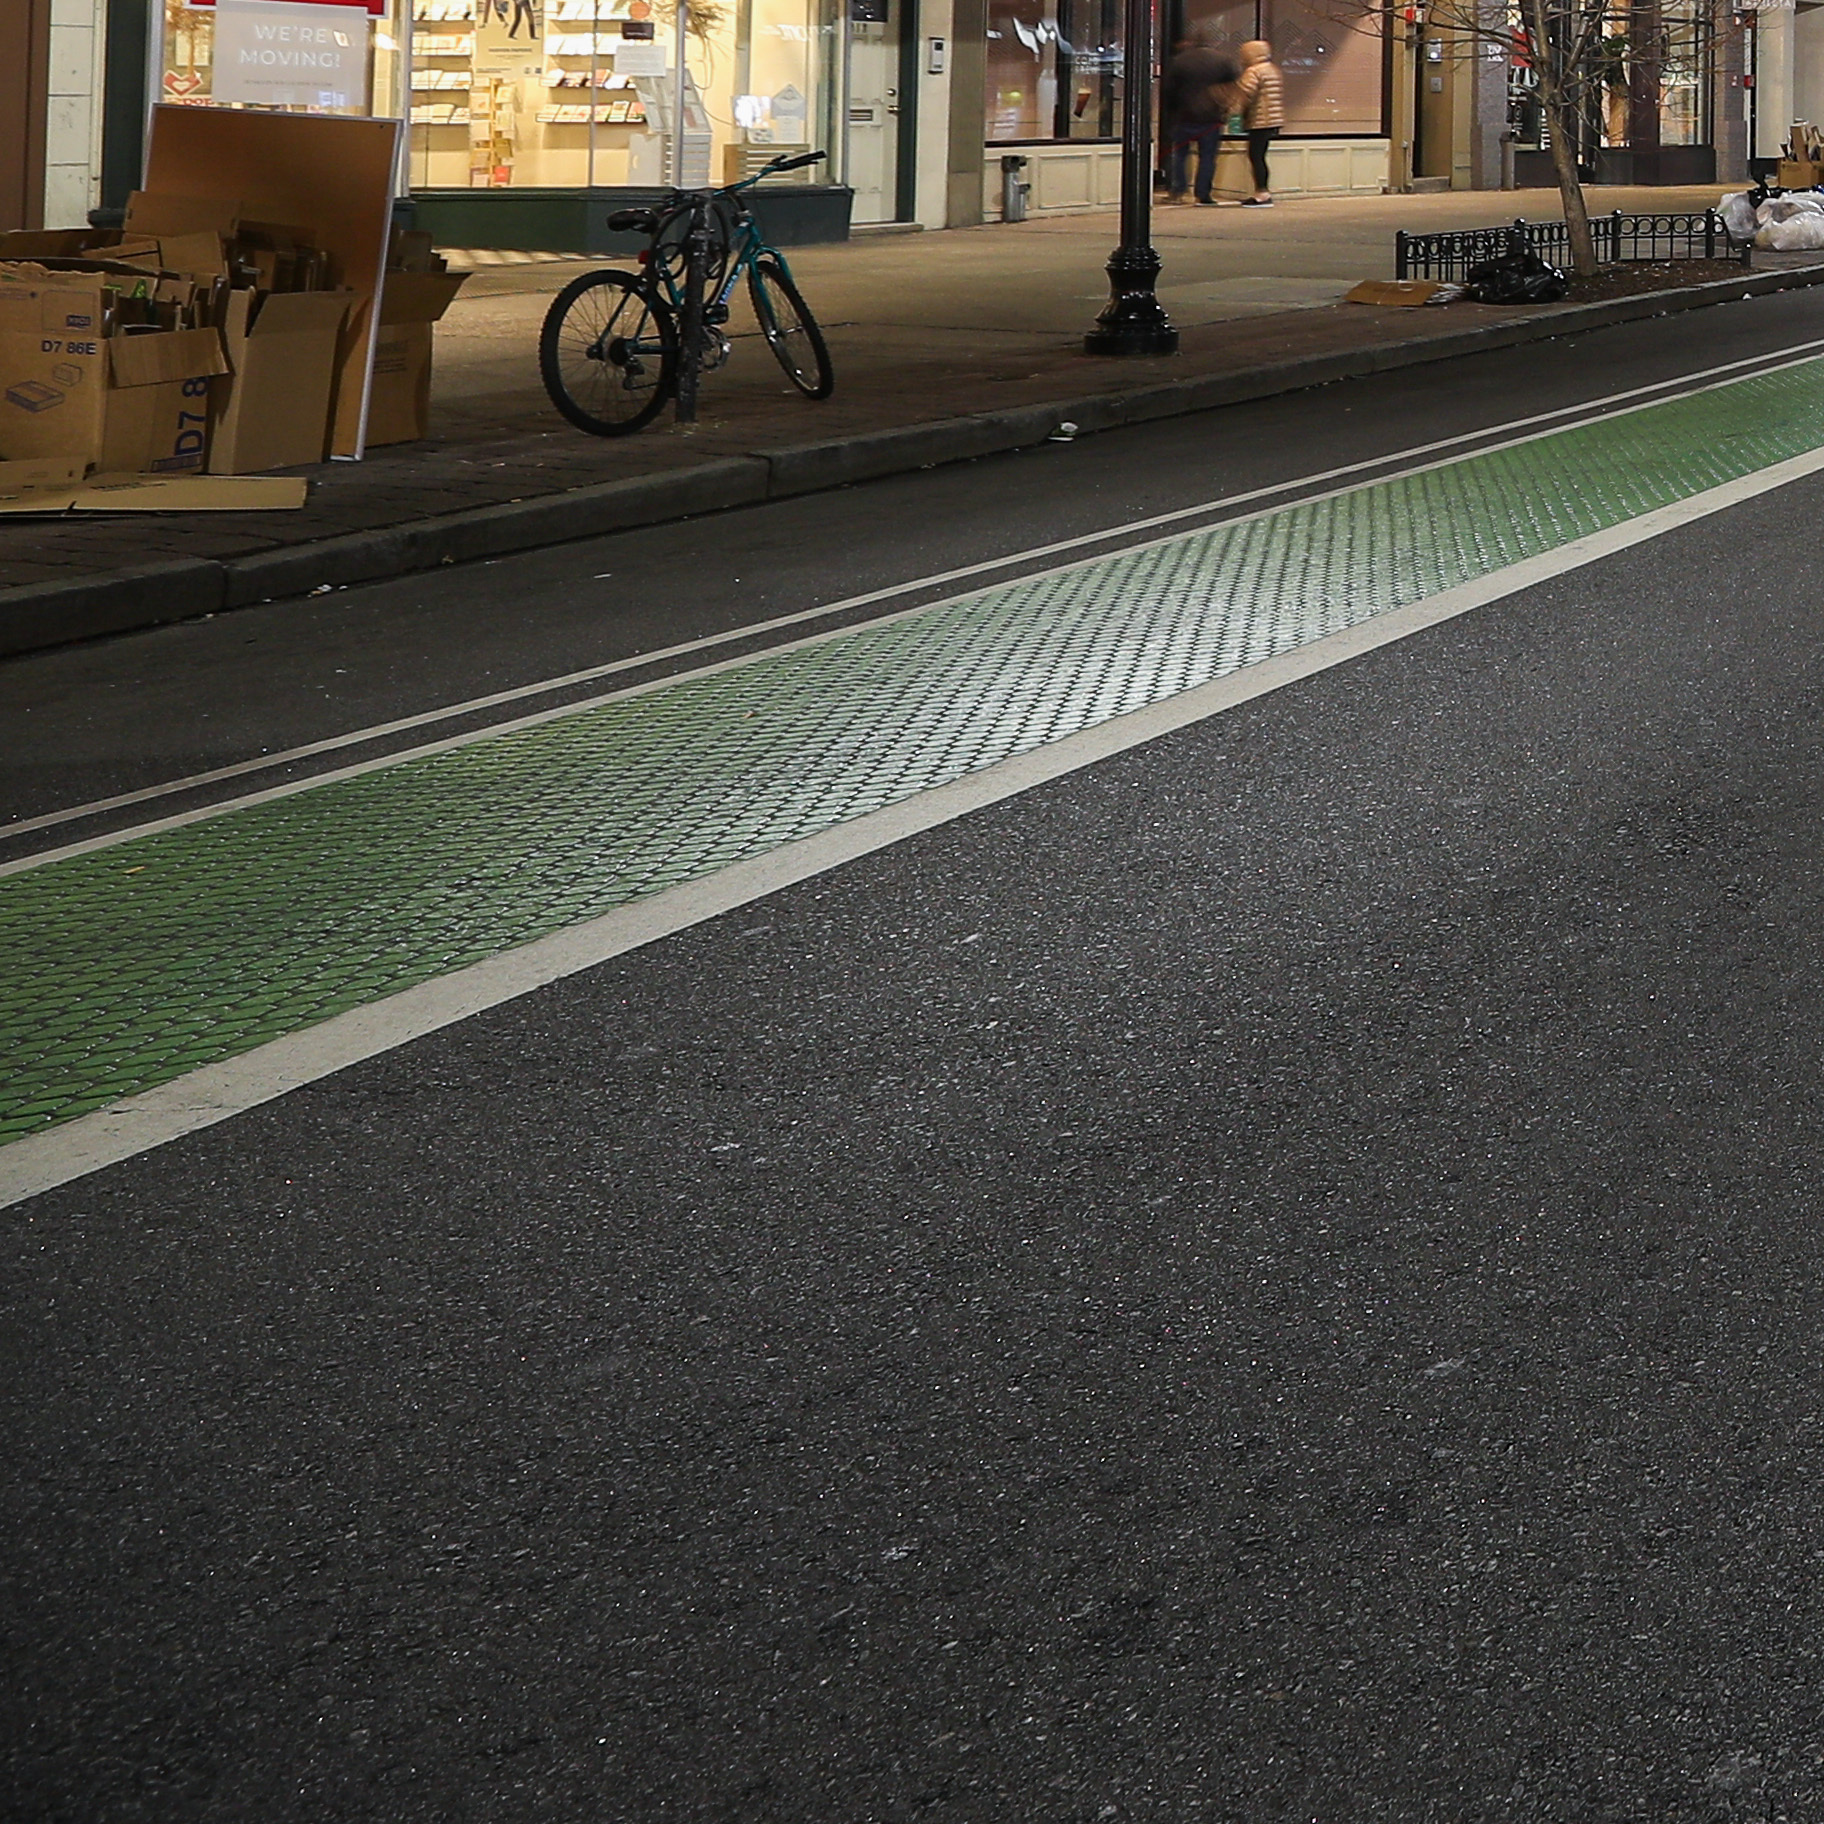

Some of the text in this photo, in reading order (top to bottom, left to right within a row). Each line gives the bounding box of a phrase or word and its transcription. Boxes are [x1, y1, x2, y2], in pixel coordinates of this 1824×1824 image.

[255, 24, 328, 44] WE'RE
[239, 48, 341, 69] MOVING!
[41, 339, 97, 355] D7 86E
[174, 410, 207, 457] D7
